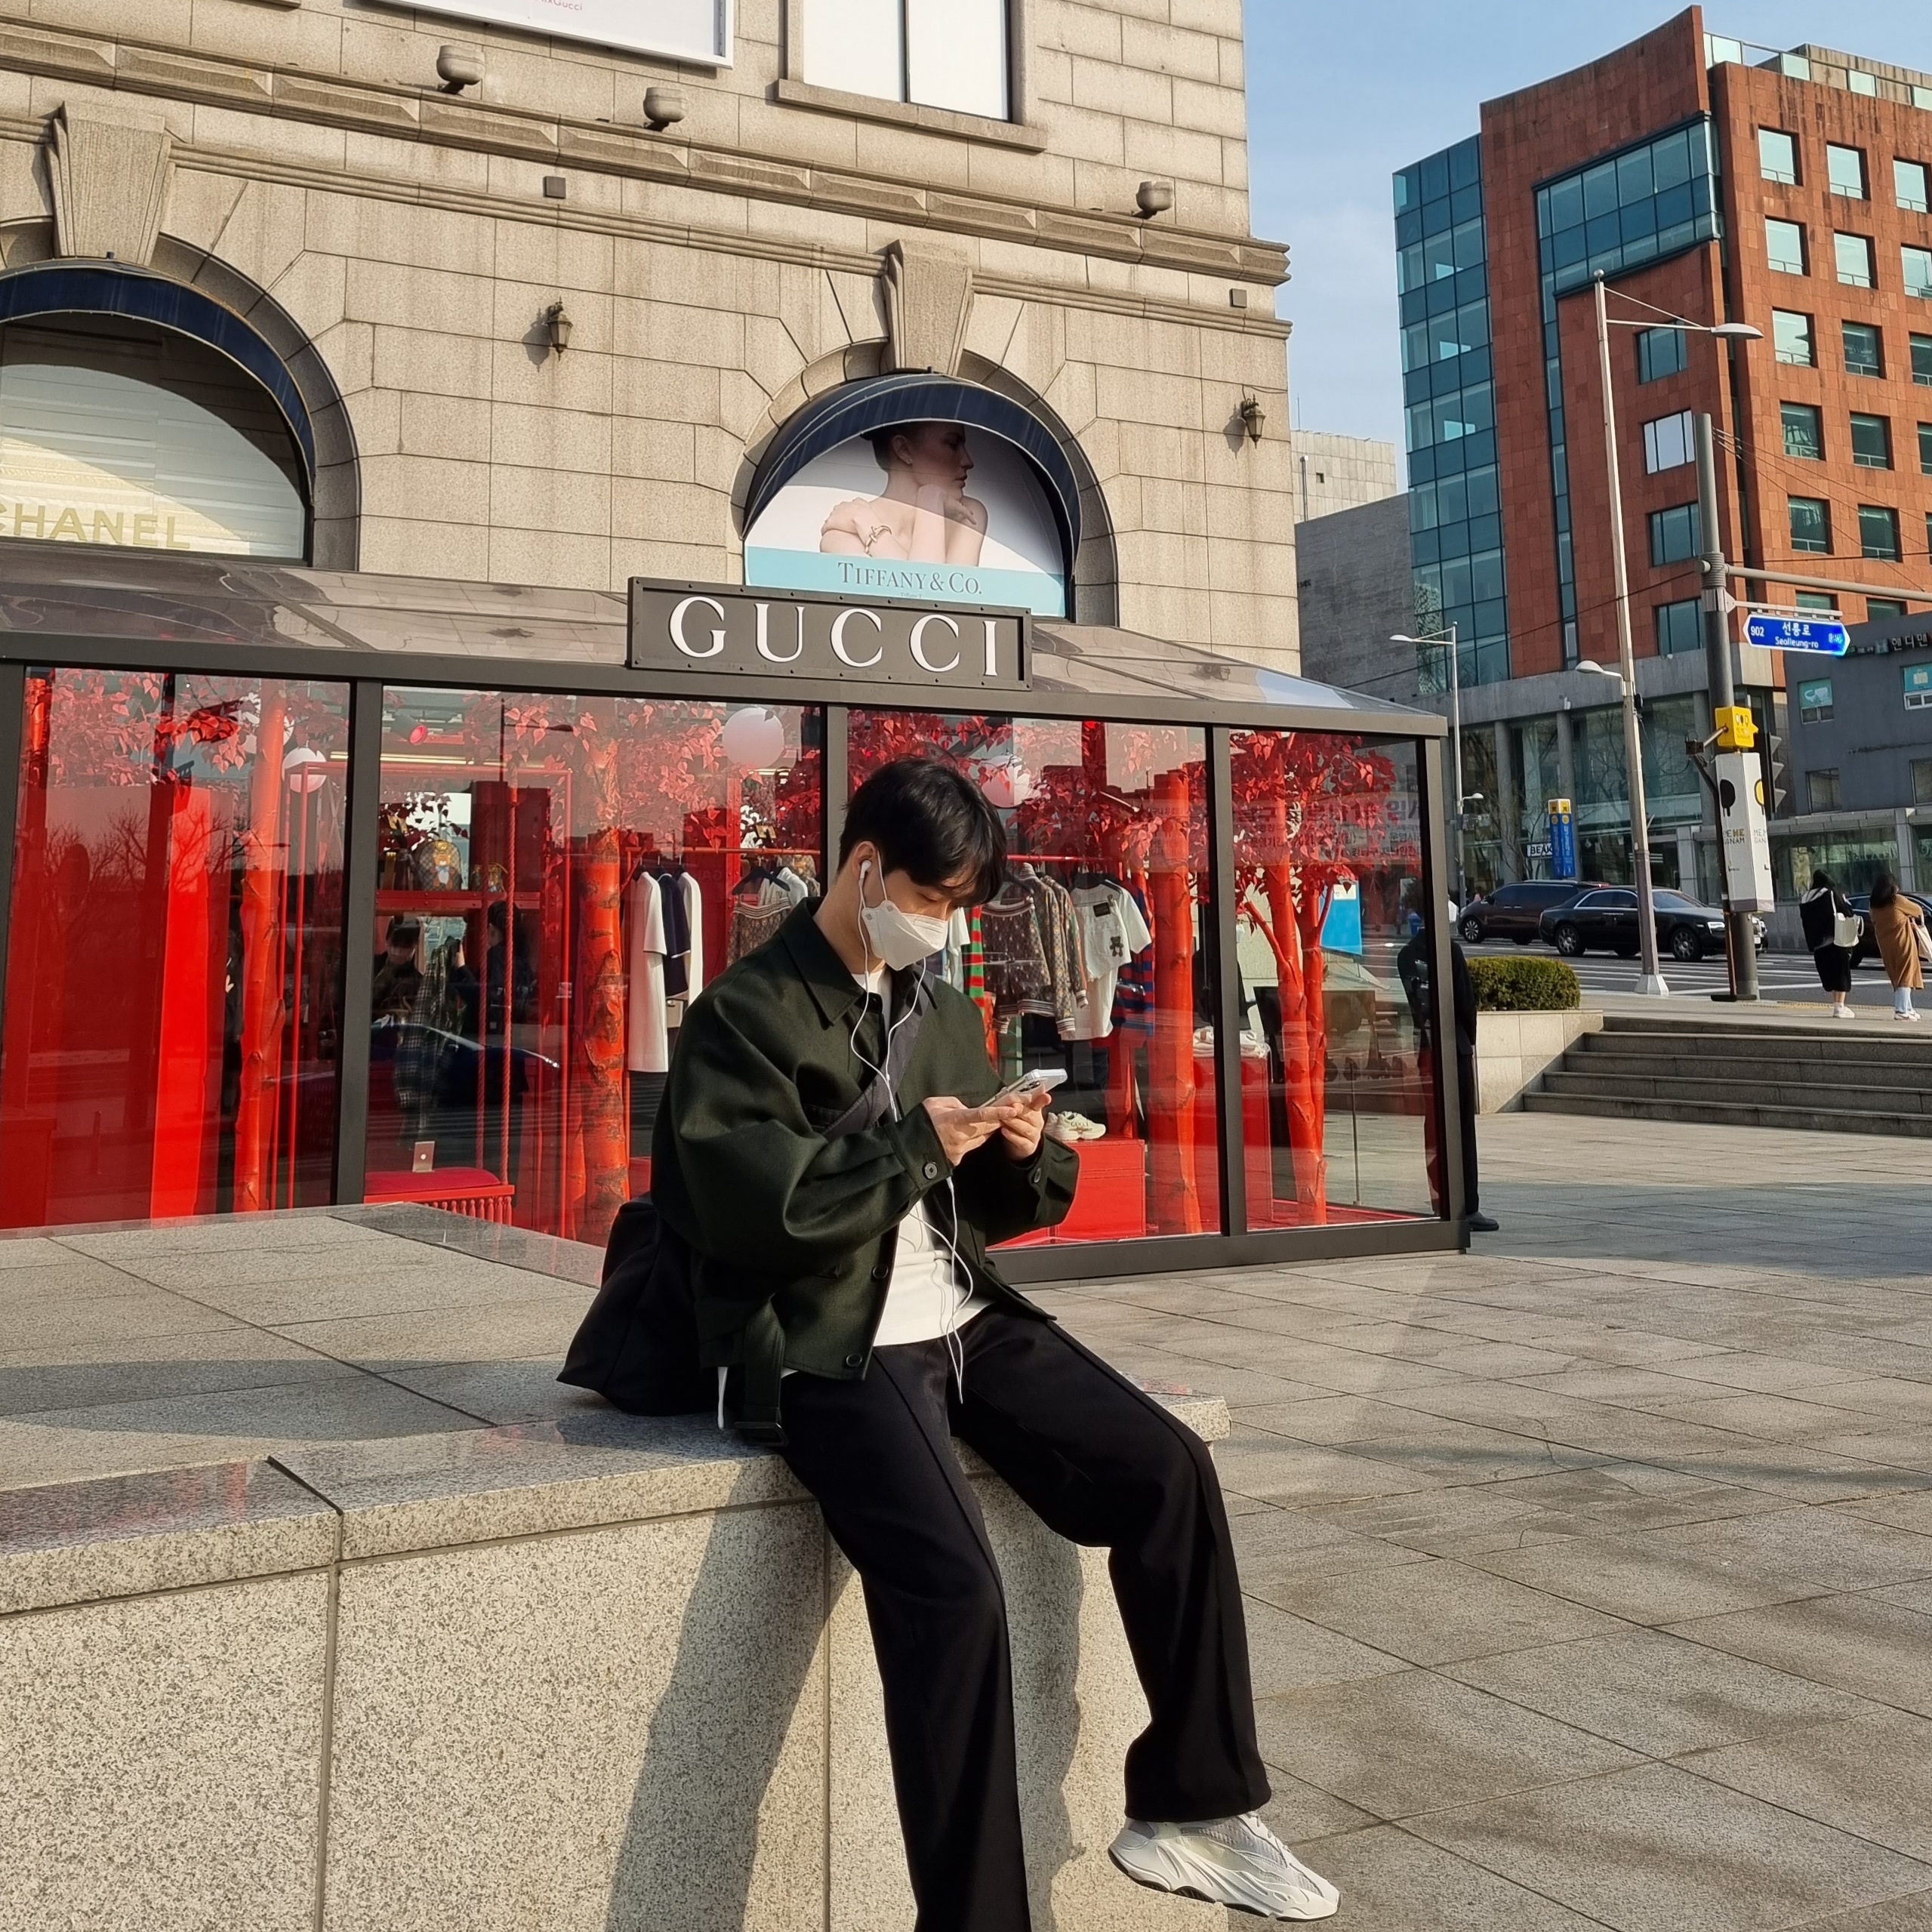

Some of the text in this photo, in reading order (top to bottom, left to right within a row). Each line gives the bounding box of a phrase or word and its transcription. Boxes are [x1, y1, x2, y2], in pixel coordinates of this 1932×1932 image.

[0, 501, 190, 549] HANEL
[669, 596, 998, 676] GUCCI
[1750, 625, 1764, 637] 902
[1782, 621, 1811, 636] 선릉로
[1775, 636, 1819, 649] Seolleung-ro
